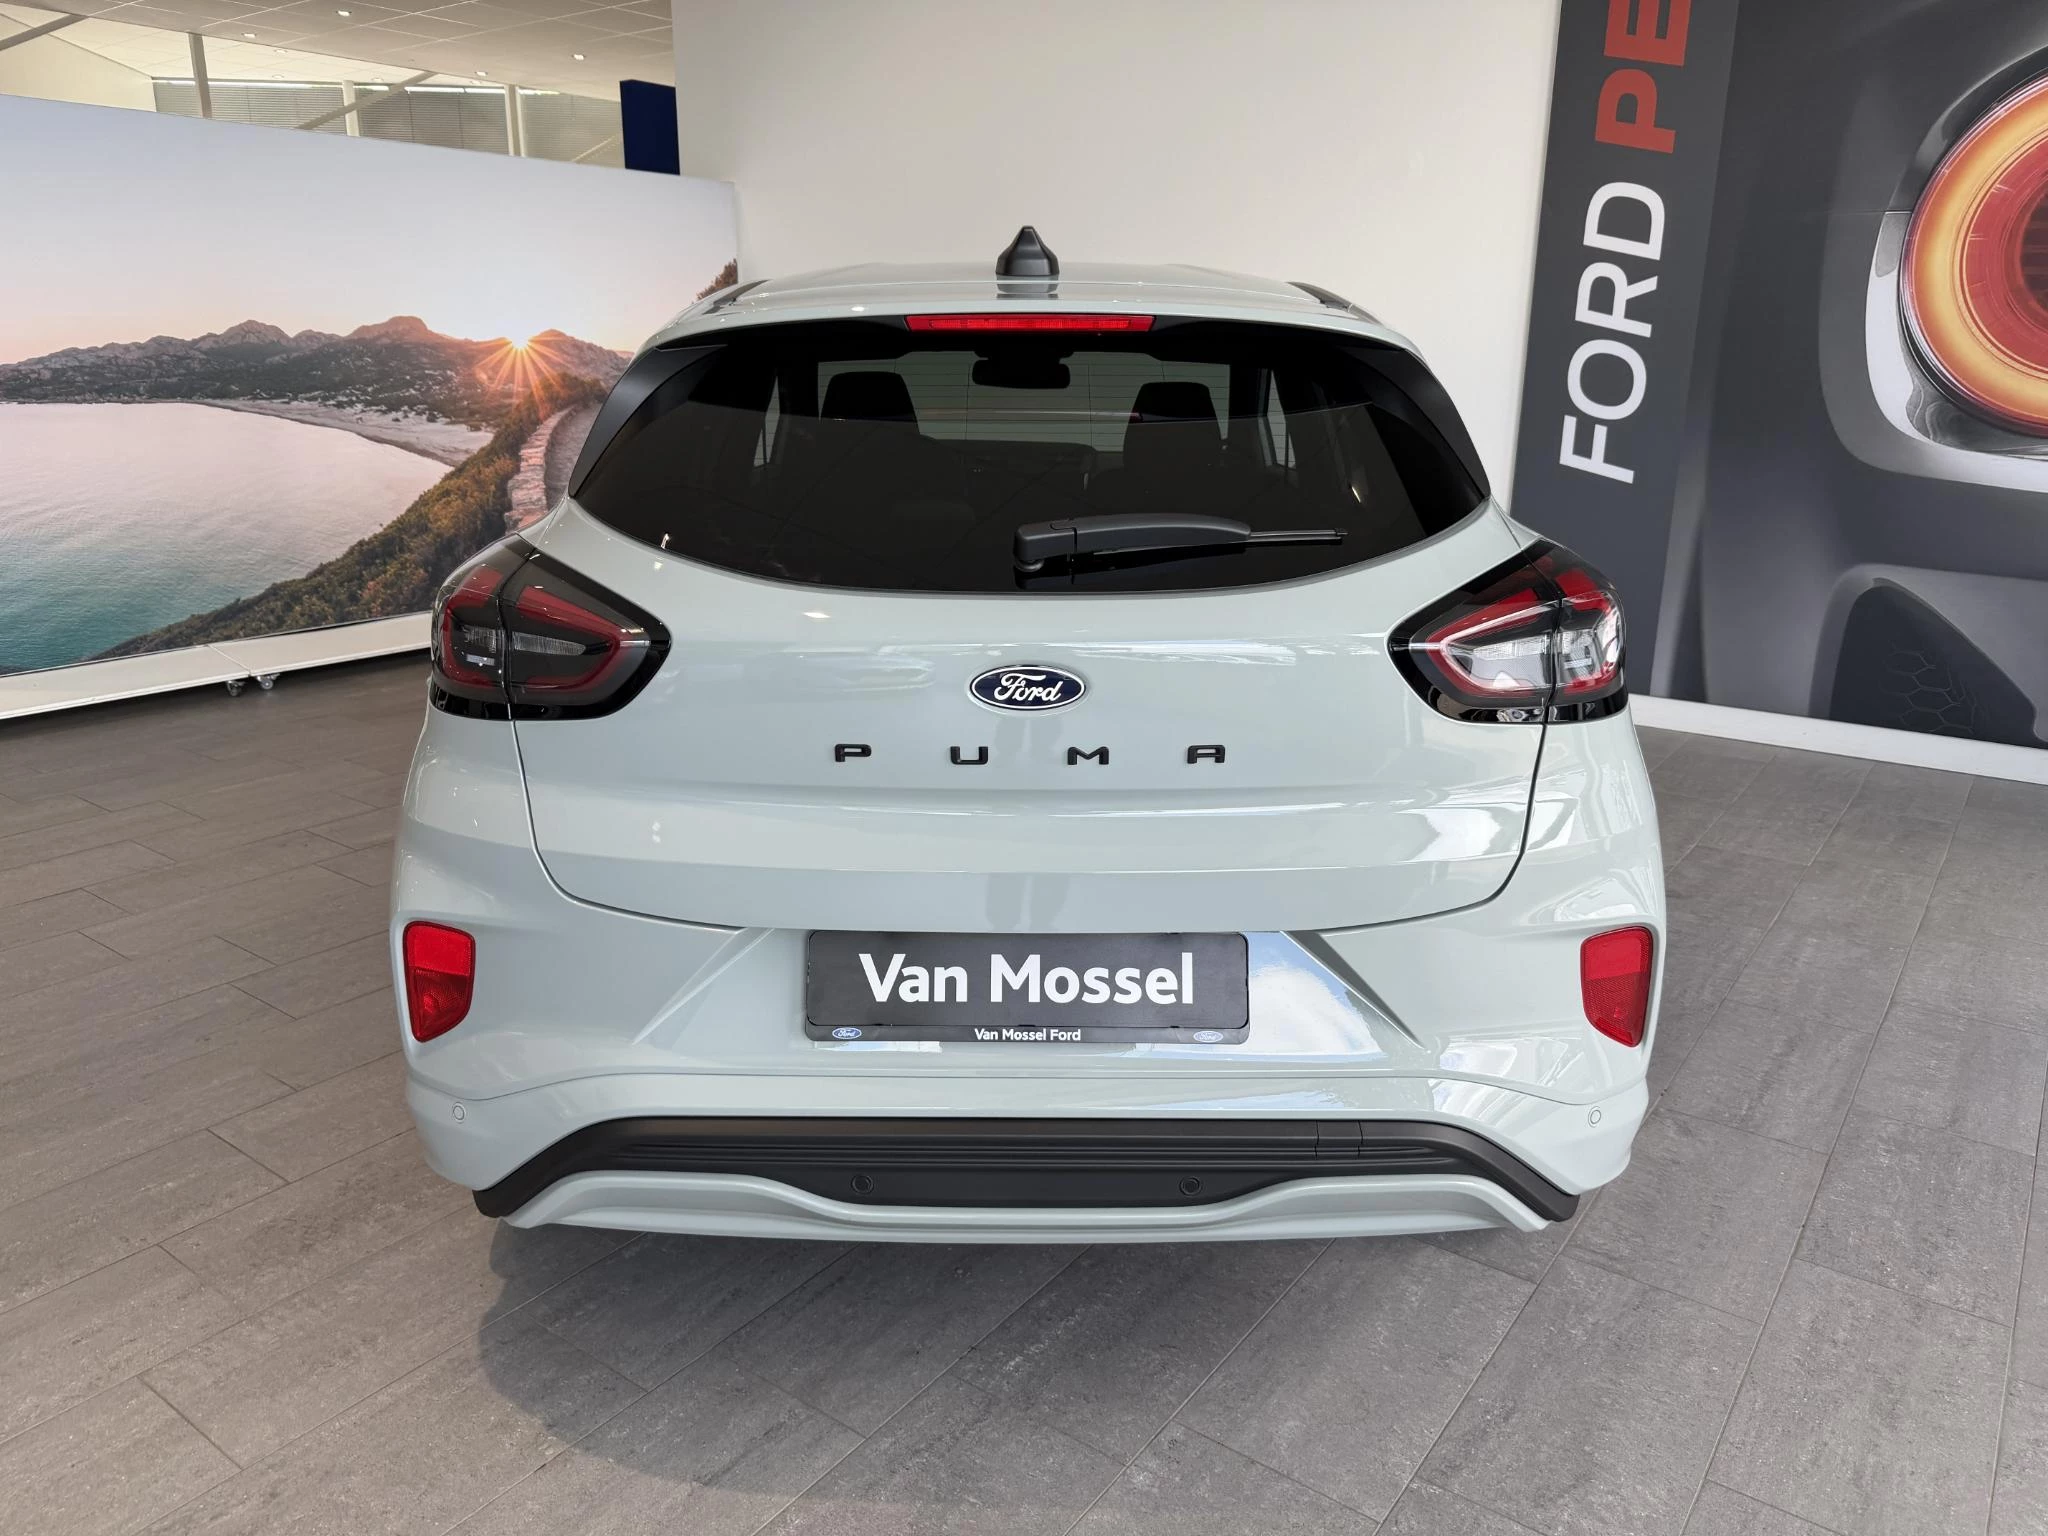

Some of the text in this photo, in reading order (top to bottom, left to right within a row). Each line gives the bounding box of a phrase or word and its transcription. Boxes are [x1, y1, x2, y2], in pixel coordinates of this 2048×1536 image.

[1558, 181, 1666, 484] FORD
[993, 672, 1064, 702] Ford
[833, 742, 1227, 767] PUMA
[858, 951, 1194, 1005] Van Mossel
[974, 1027, 1082, 1041] Van Mossel Ford
